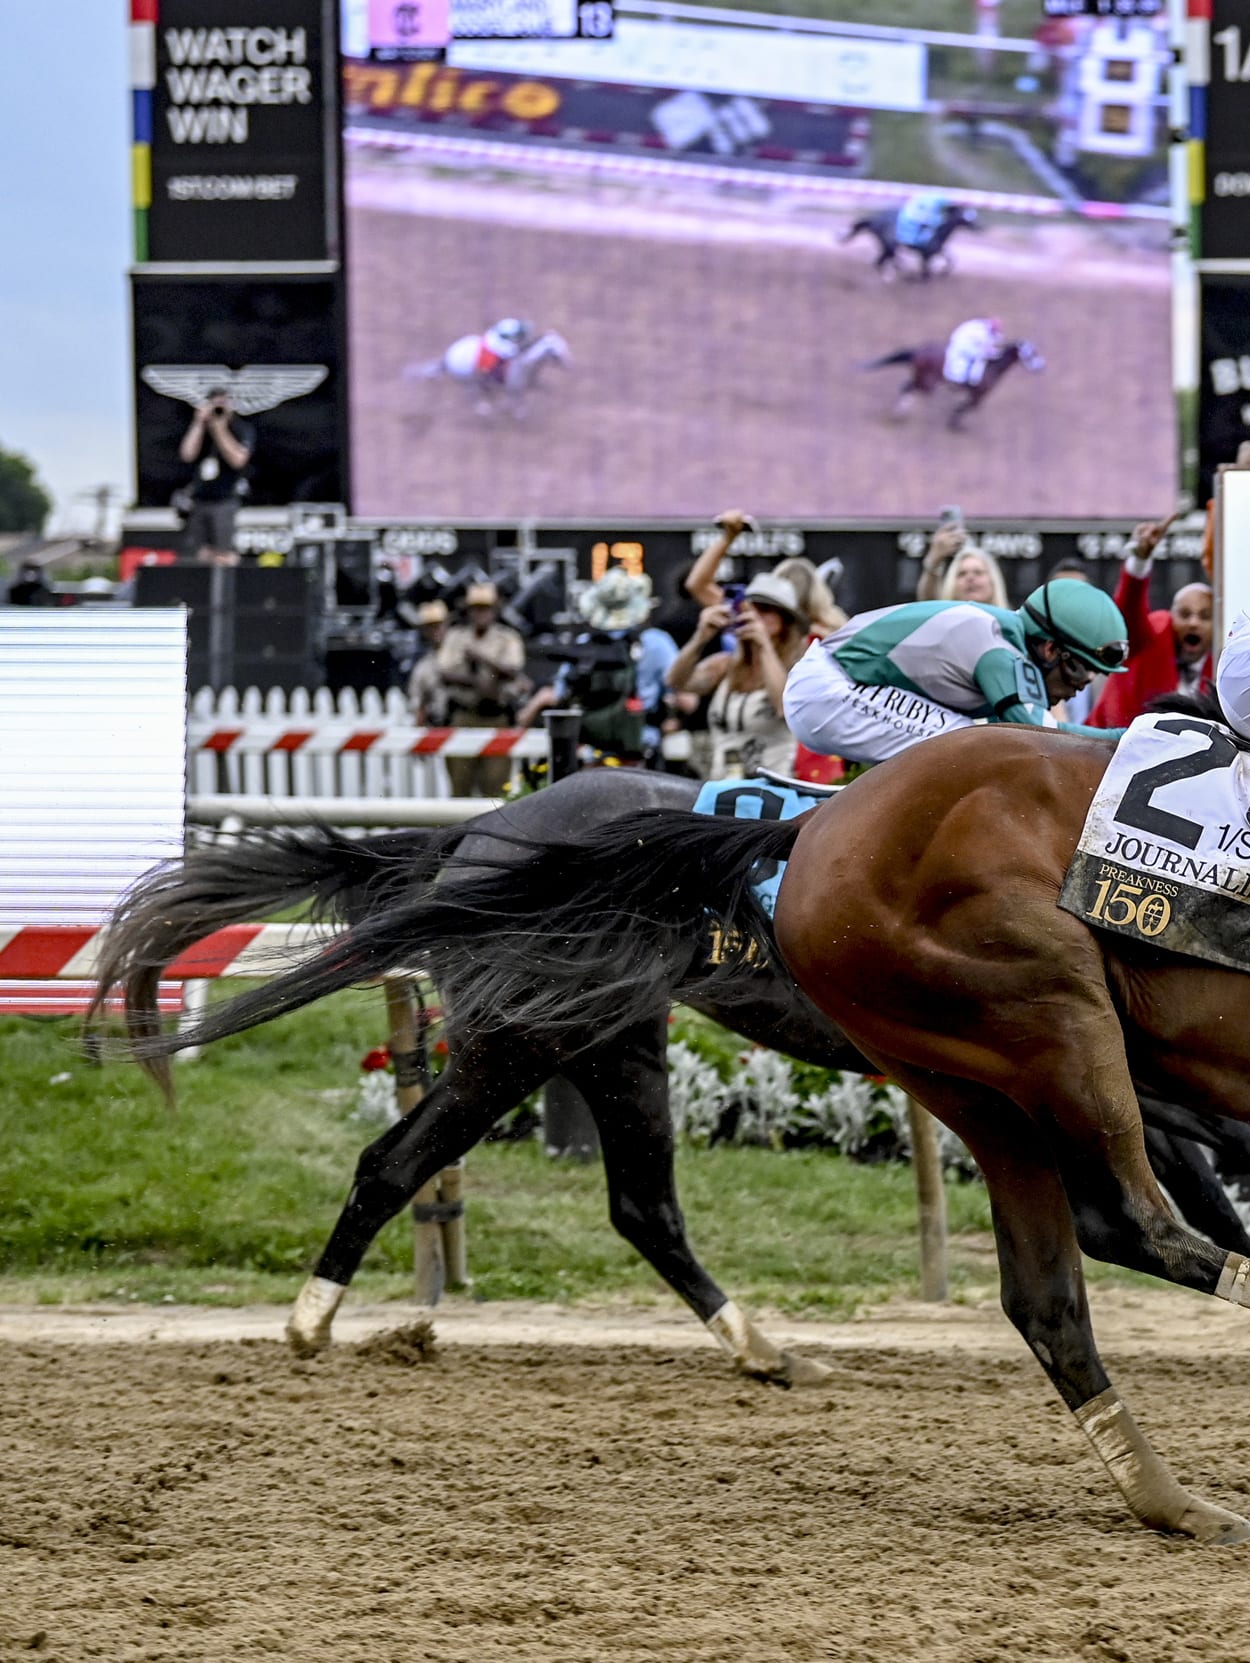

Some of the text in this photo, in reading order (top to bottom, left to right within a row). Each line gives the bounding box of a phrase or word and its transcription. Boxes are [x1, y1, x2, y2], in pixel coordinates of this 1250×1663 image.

[165, 27, 306, 65] WATCH
[166, 66, 312, 104] WAGER
[167, 107, 248, 144] WIN
[1022, 662, 1042, 700] 9
[884, 688, 949, 729] RUBY'S
[1113, 719, 1239, 851] 2
[1099, 864, 1179, 897] PREAKNESS
[1085, 879, 1171, 937] 150
